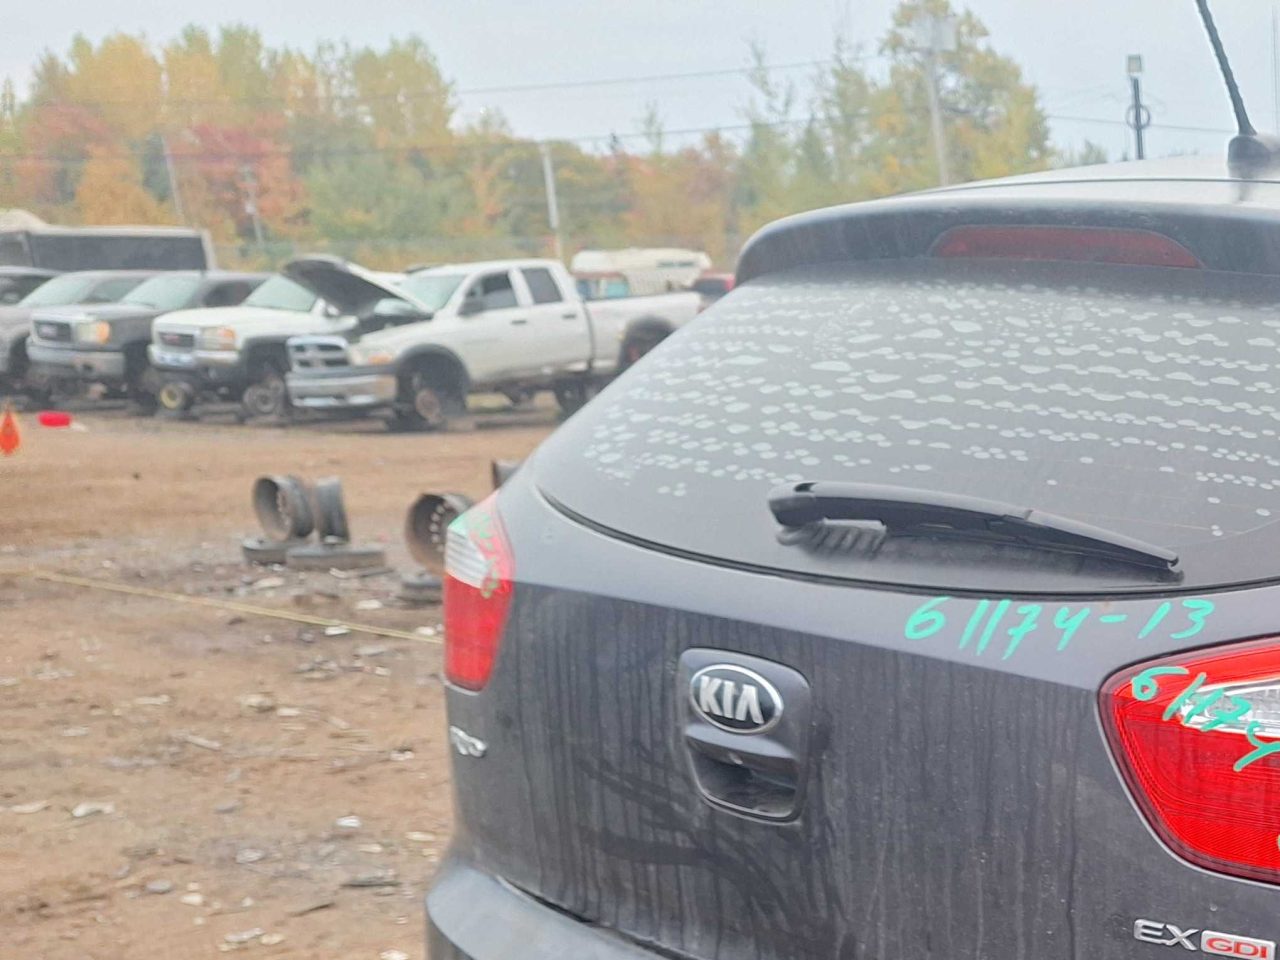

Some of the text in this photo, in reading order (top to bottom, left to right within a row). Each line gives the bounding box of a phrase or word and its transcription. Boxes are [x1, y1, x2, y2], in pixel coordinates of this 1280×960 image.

[699, 674, 765, 725] KIA
[1133, 918, 1268, 959] EX GDI
